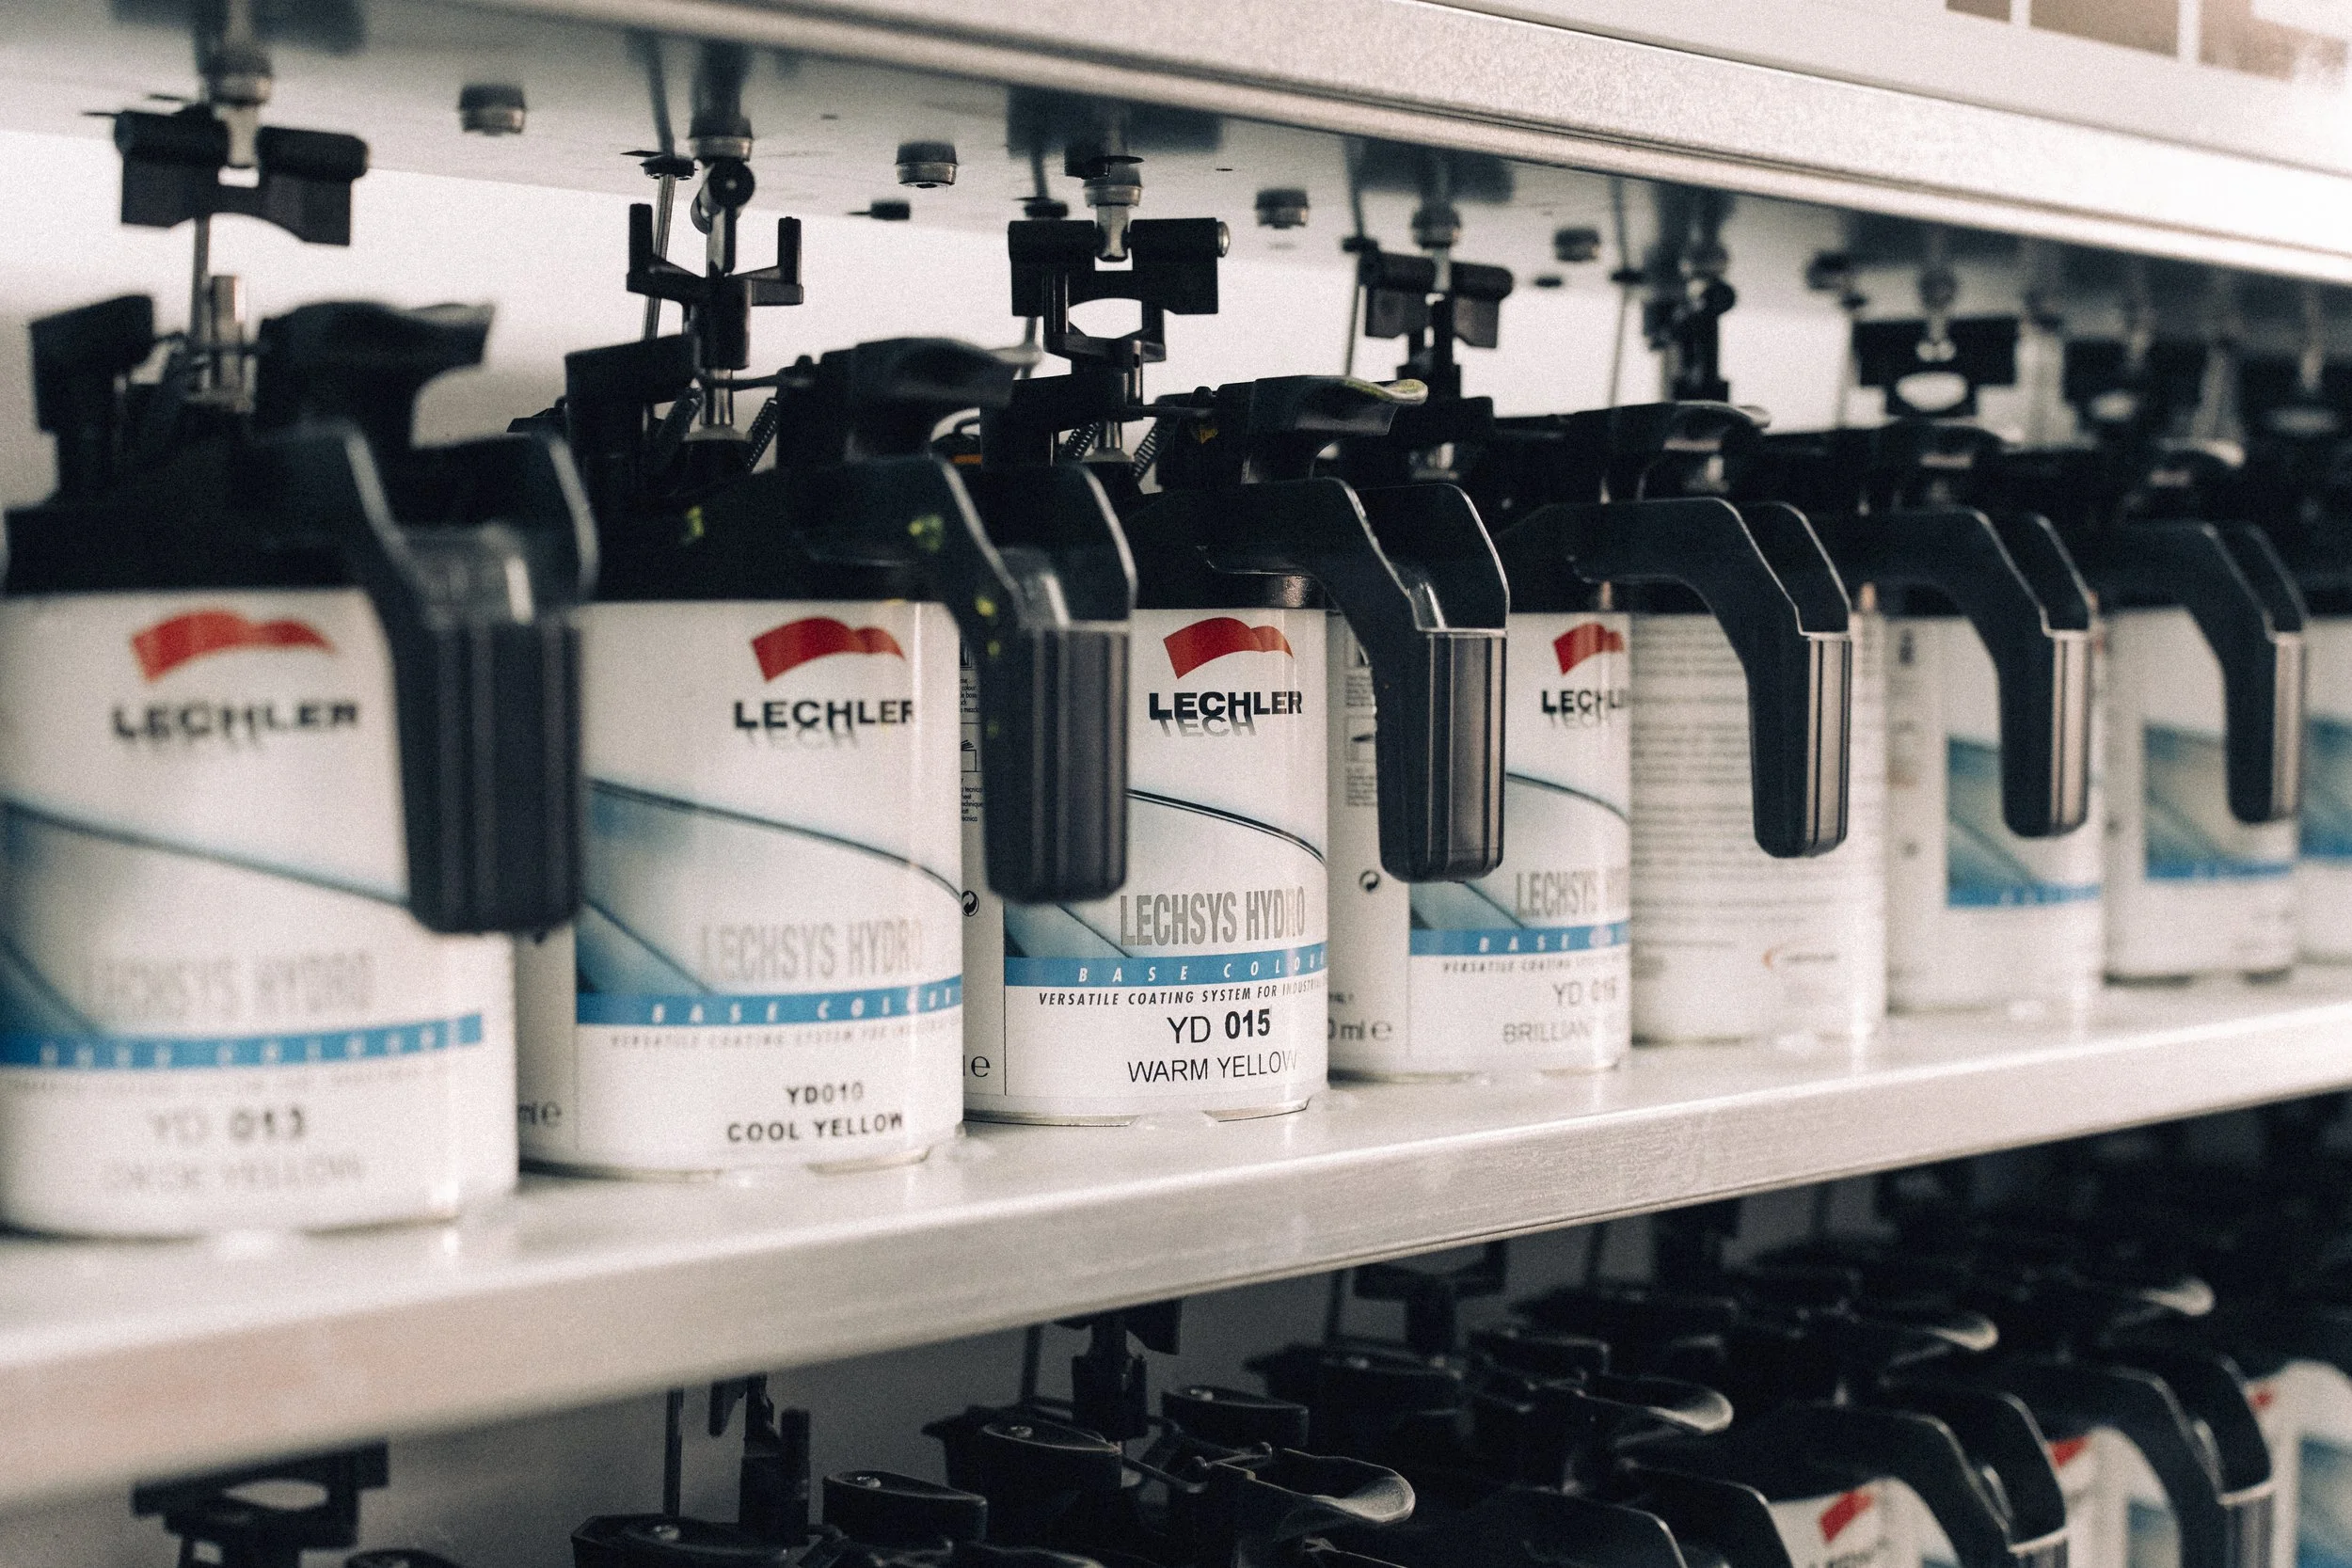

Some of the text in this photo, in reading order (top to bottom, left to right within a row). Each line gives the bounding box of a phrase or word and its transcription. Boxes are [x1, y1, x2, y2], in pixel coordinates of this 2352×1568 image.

[111, 700, 359, 740] LECHLER
[1149, 690, 1303, 721] LECHLER
[1120, 886, 1306, 946] LECHSYS HYDRO
[1078, 965, 1189, 983] BASE
[1039, 992, 1120, 1006] VERSATILE
[1128, 990, 1195, 1006] COATING
[1201, 988, 1251, 1003] SYSTEM
[1257, 985, 1278, 999] FOR
[1168, 1007, 1271, 1044] YD 015
[1127, 1050, 1298, 1083] WARM YELLOW
[786, 1083, 865, 1104] YD010
[725, 1112, 904, 1143] COOL YELLOW
